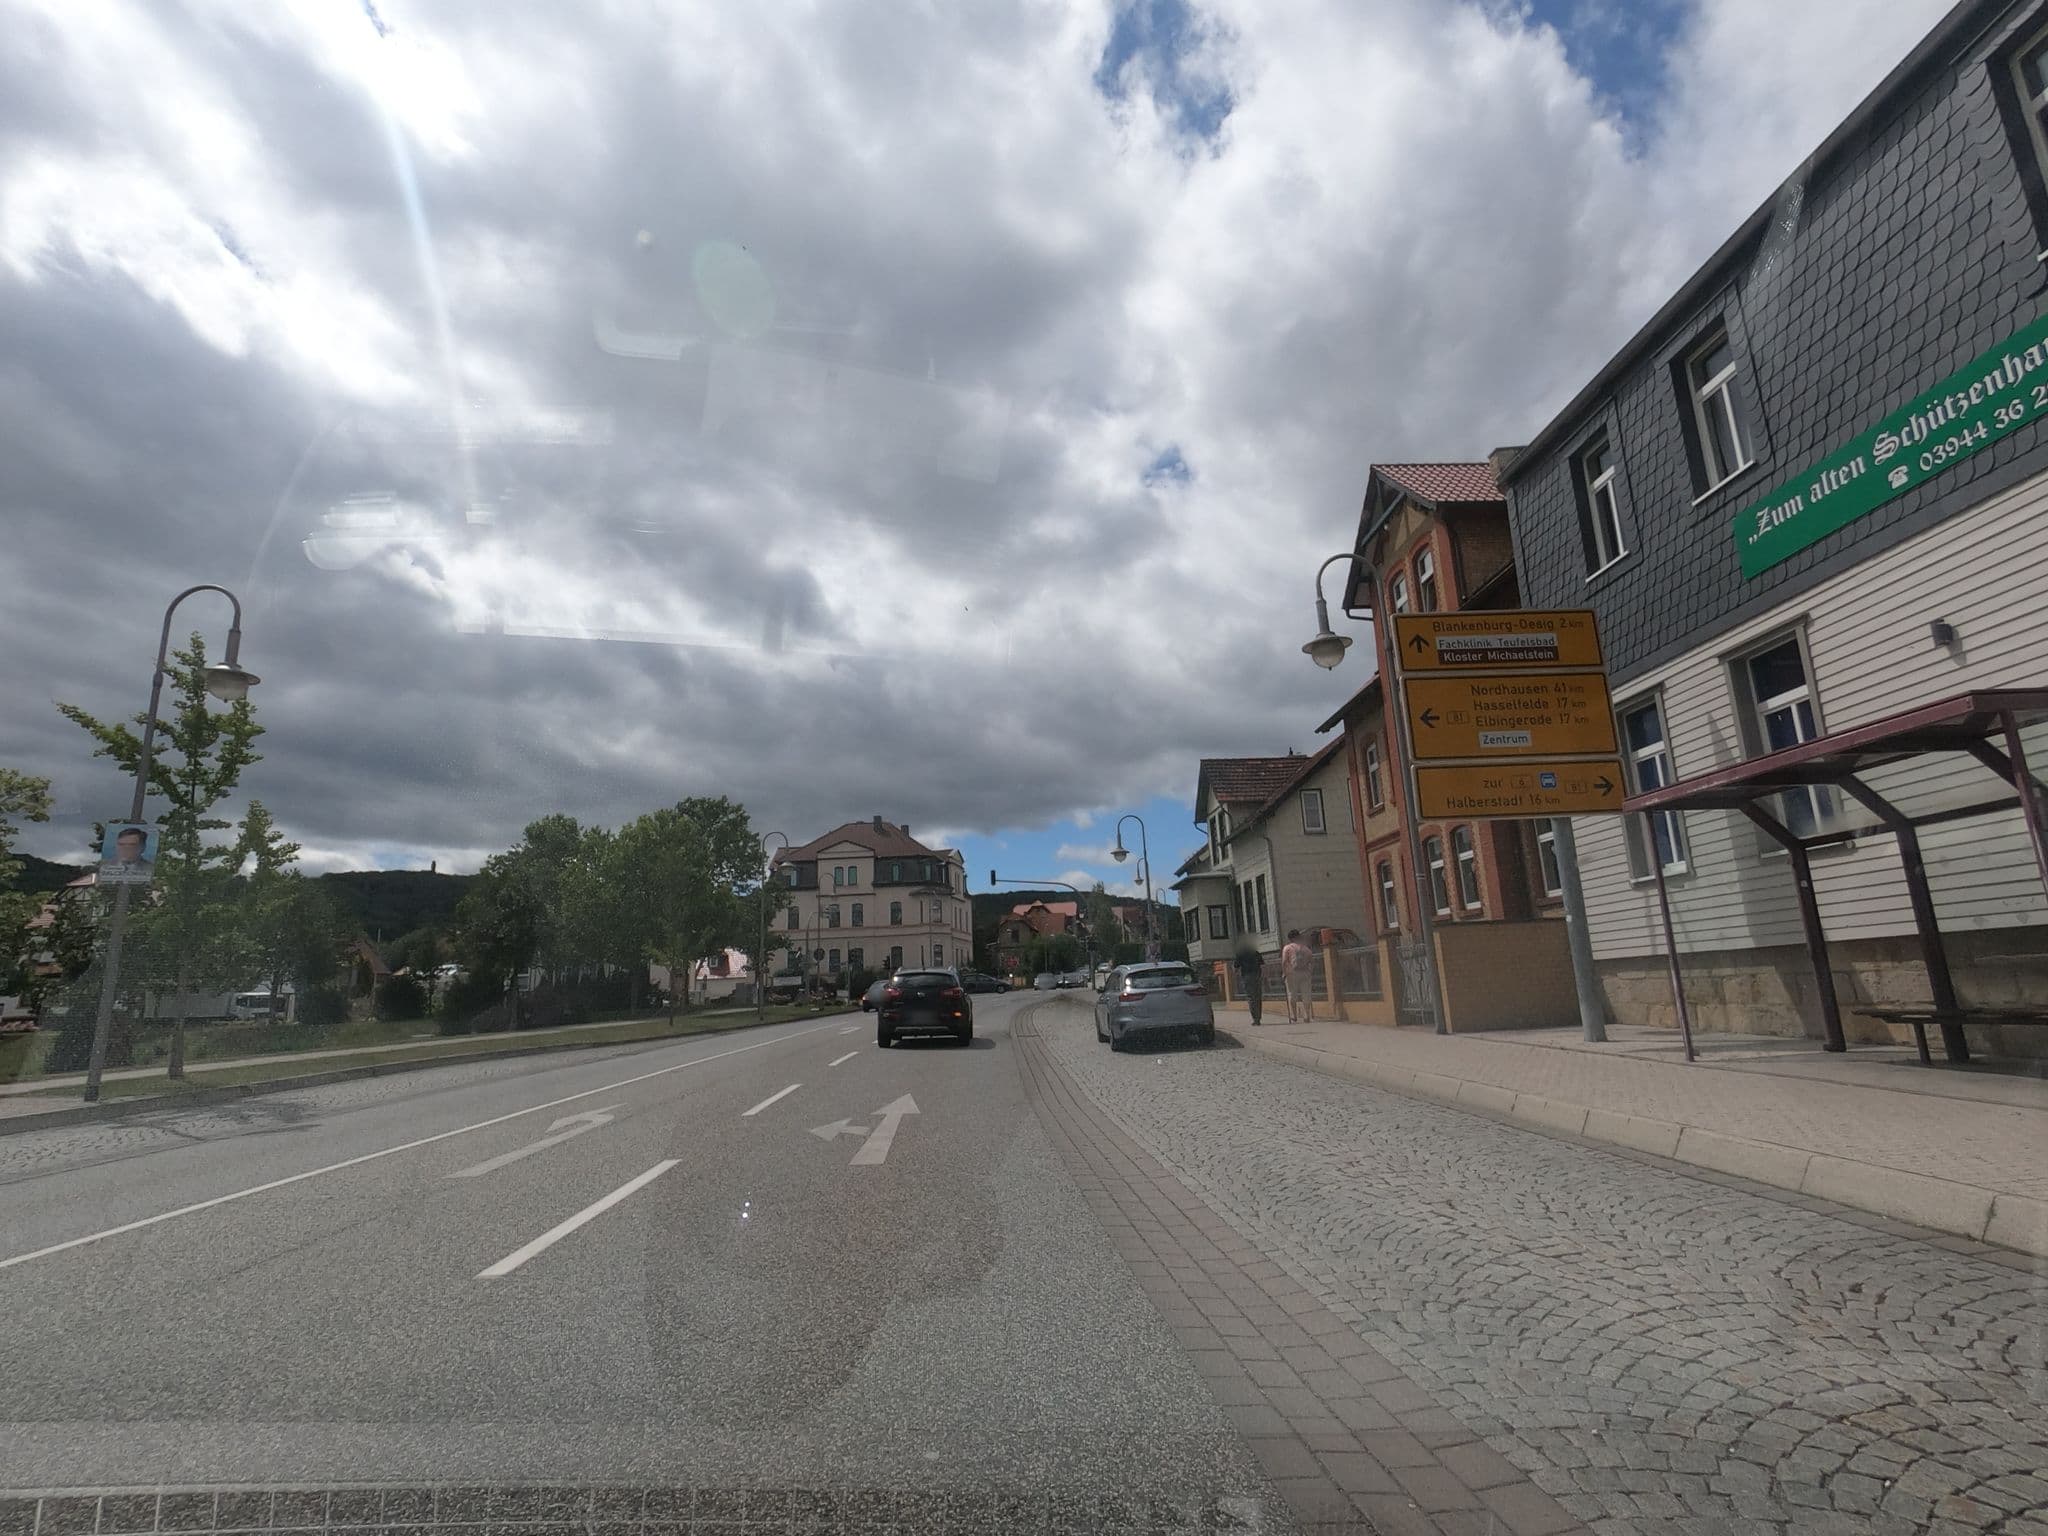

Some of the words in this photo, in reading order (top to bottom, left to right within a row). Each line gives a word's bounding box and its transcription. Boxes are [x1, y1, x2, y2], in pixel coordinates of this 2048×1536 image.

[1919, 420, 1988, 472] 03944
[1993, 399, 2025, 429] 36
[2031, 382, 2048, 410] 2
[1810, 455, 1867, 504] alten
[1560, 618, 1568, 629] 2
[1569, 620, 1584, 629] km
[1438, 637, 1493, 649] Fachklinik
[1497, 636, 1555, 647] Teufelsbad
[1443, 653, 1483, 662] Kloster
[1487, 650, 1555, 661] Michaelstein
[1471, 684, 1548, 696] Nordhausen
[1553, 683, 1567, 694] 41
[1473, 699, 1550, 711] Hasselfelde
[1556, 697, 1568, 708] 17
[1475, 714, 1552, 728] Elbingerode
[1559, 713, 1570, 724] 17
[1574, 716, 1588, 724] km
[1483, 734, 1529, 745] Zentrum
[1483, 778, 1503, 789] zur
[1446, 795, 1523, 808] Halberstadt
[1529, 795, 1542, 806] 16
[1545, 797, 1561, 805] km
